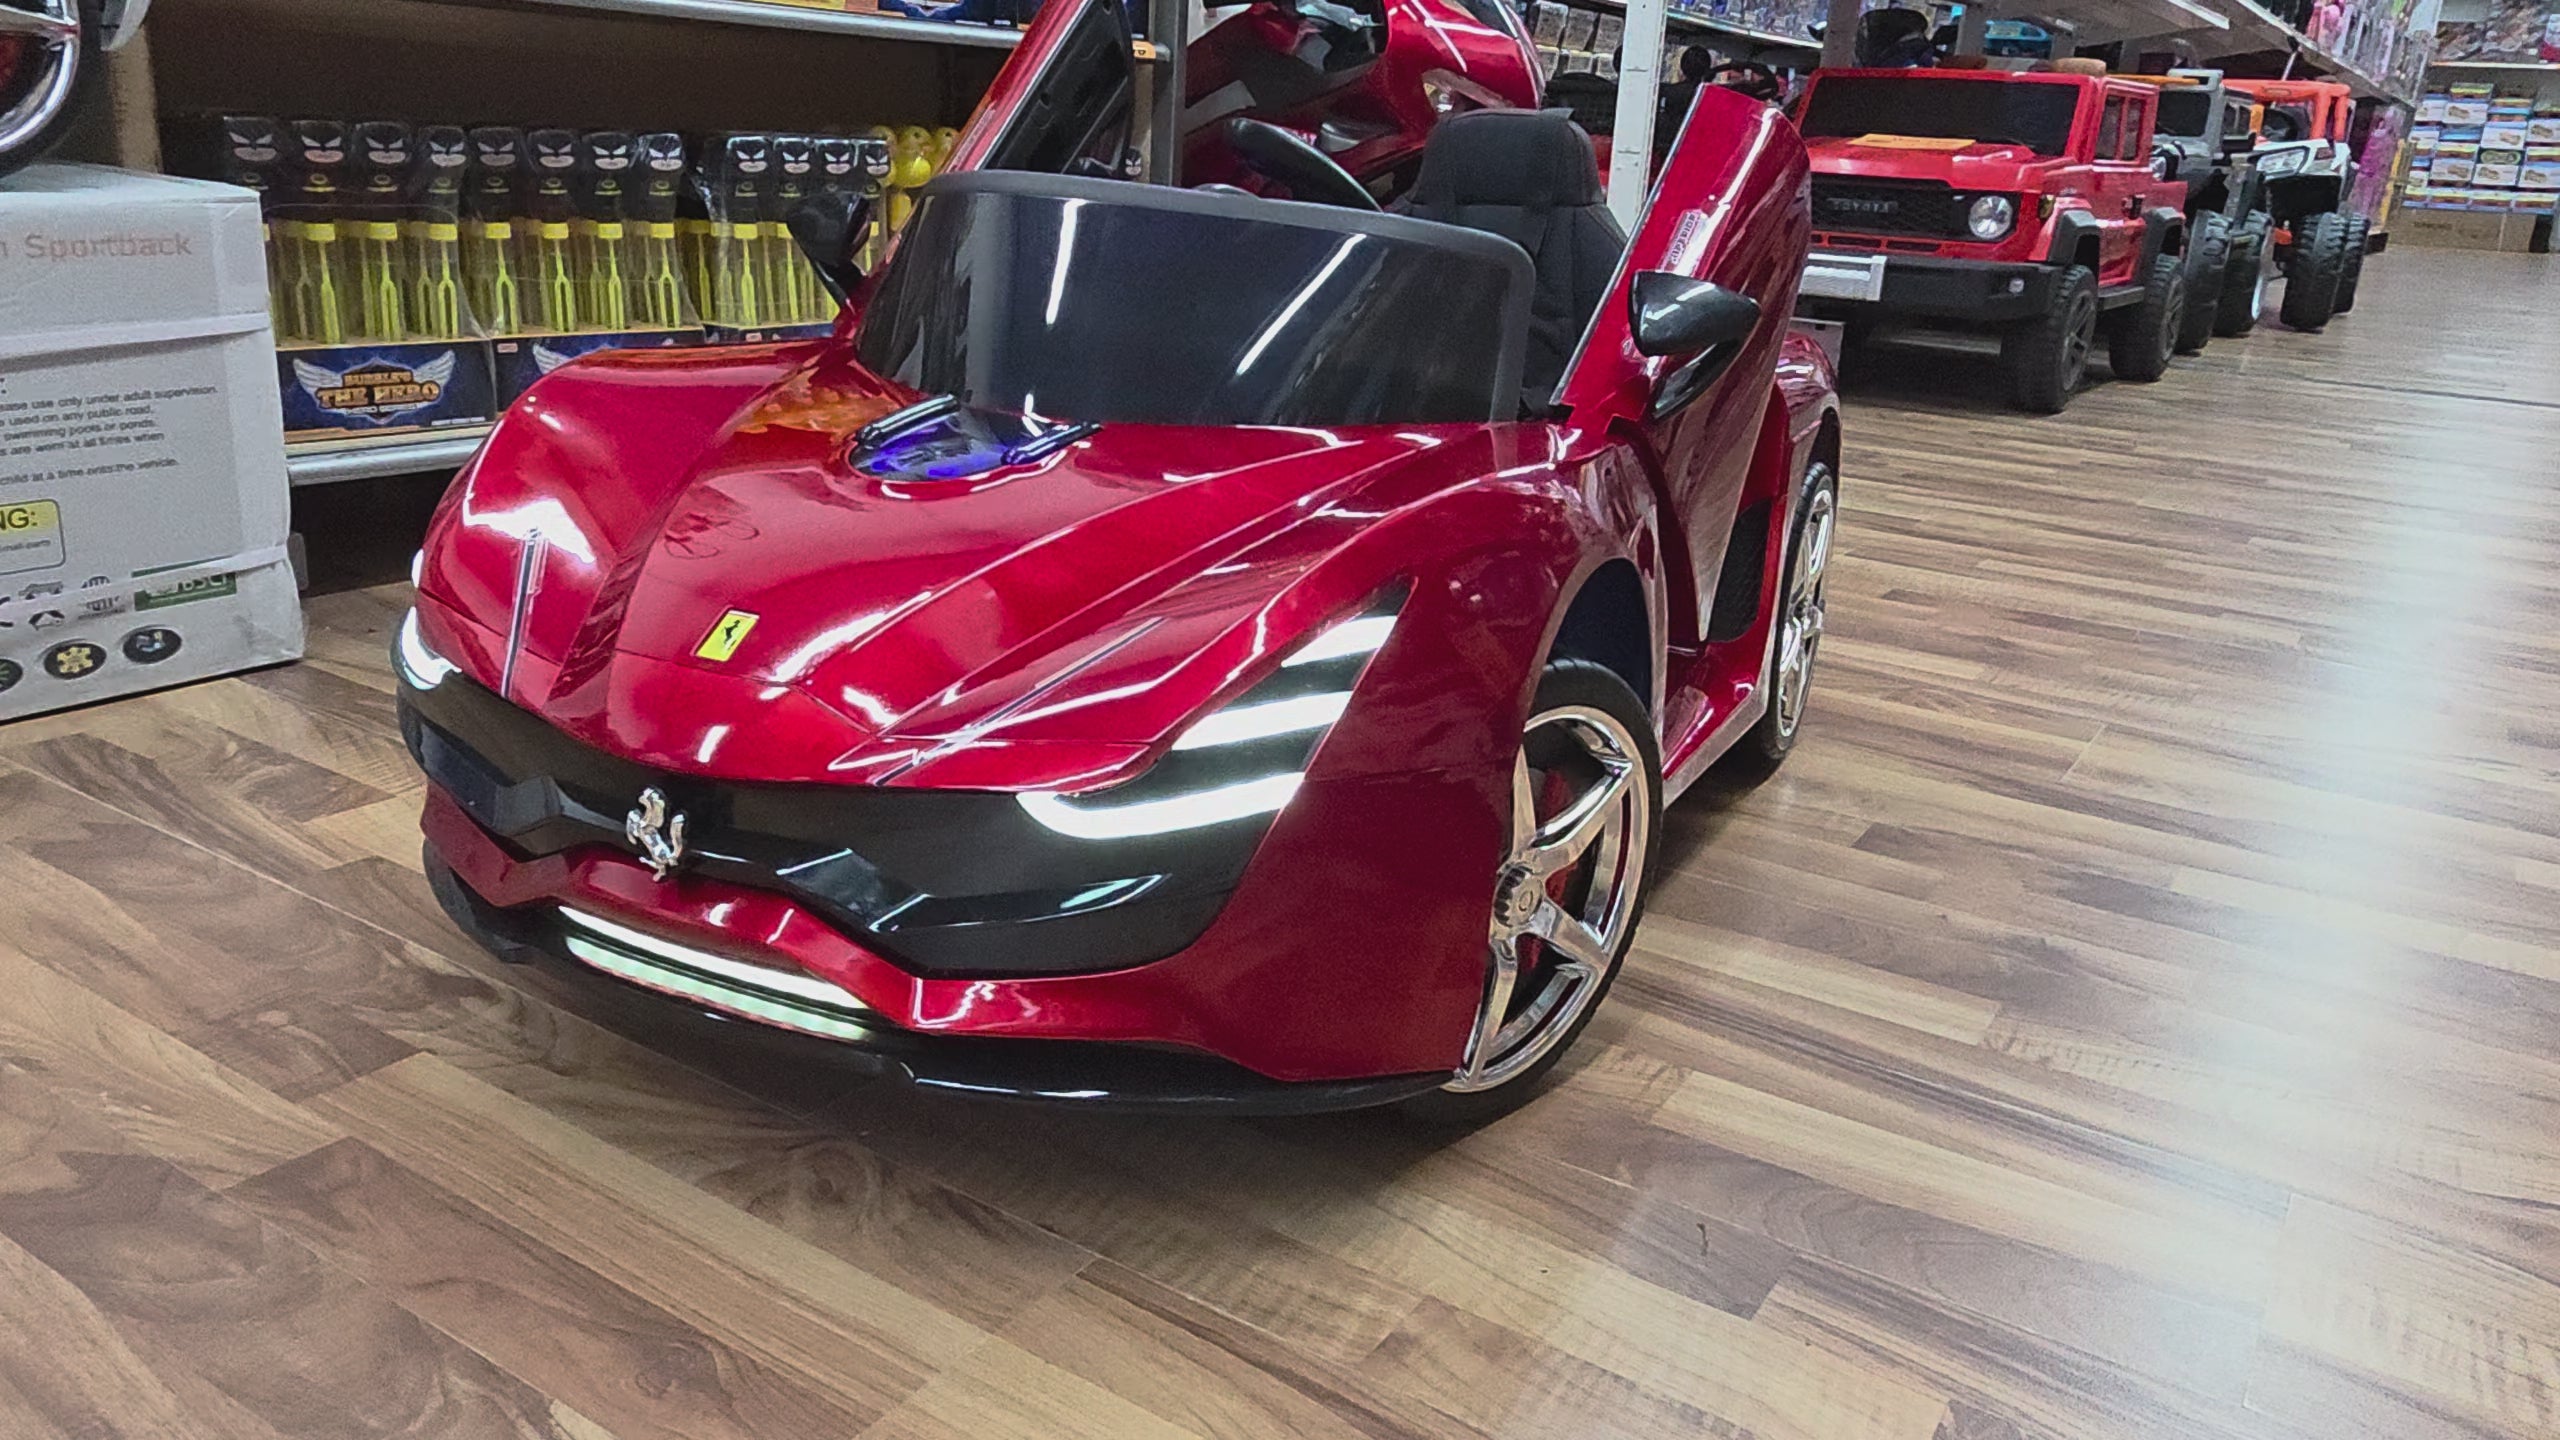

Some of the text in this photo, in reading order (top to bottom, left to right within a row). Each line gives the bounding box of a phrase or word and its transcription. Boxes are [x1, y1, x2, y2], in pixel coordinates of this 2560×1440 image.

[25, 232, 192, 262] Sportback
[32, 400, 53, 409] use
[58, 396, 82, 408] only
[86, 394, 119, 404] under
[124, 390, 151, 401] adult
[317, 382, 439, 408] THE HERO
[9, 415, 39, 426] used
[62, 412, 83, 421] any
[87, 407, 123, 420] public
